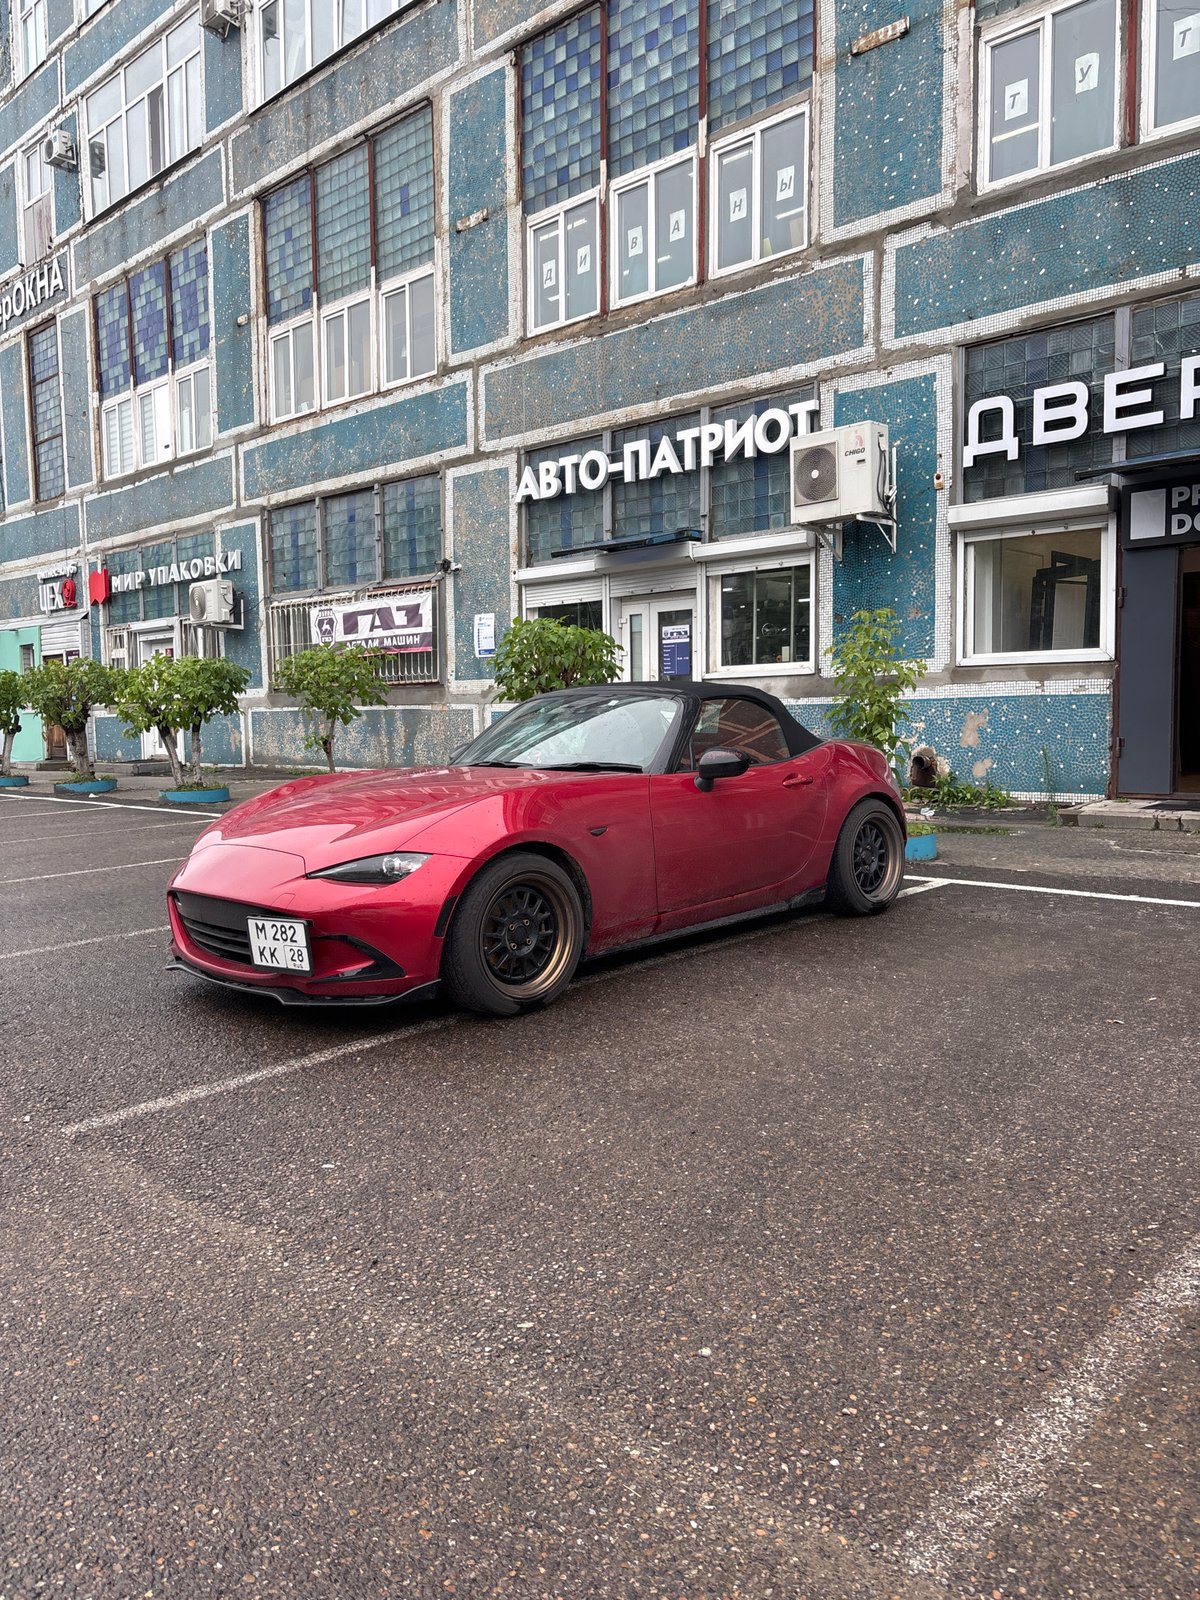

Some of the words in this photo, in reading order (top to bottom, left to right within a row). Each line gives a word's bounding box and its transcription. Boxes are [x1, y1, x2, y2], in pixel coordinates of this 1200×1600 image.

[516, 399, 819, 503] АВТО-ПАТРИОТ
[844, 447, 866, 457] CHIGO
[111, 571, 145, 593] МИР
[148, 549, 242, 586] УПАКОВКИ
[342, 602, 423, 636] ГАЗ
[383, 635, 420, 647] МАШИН
[270, 923, 298, 943] 282
[289, 948, 304, 963] 28
